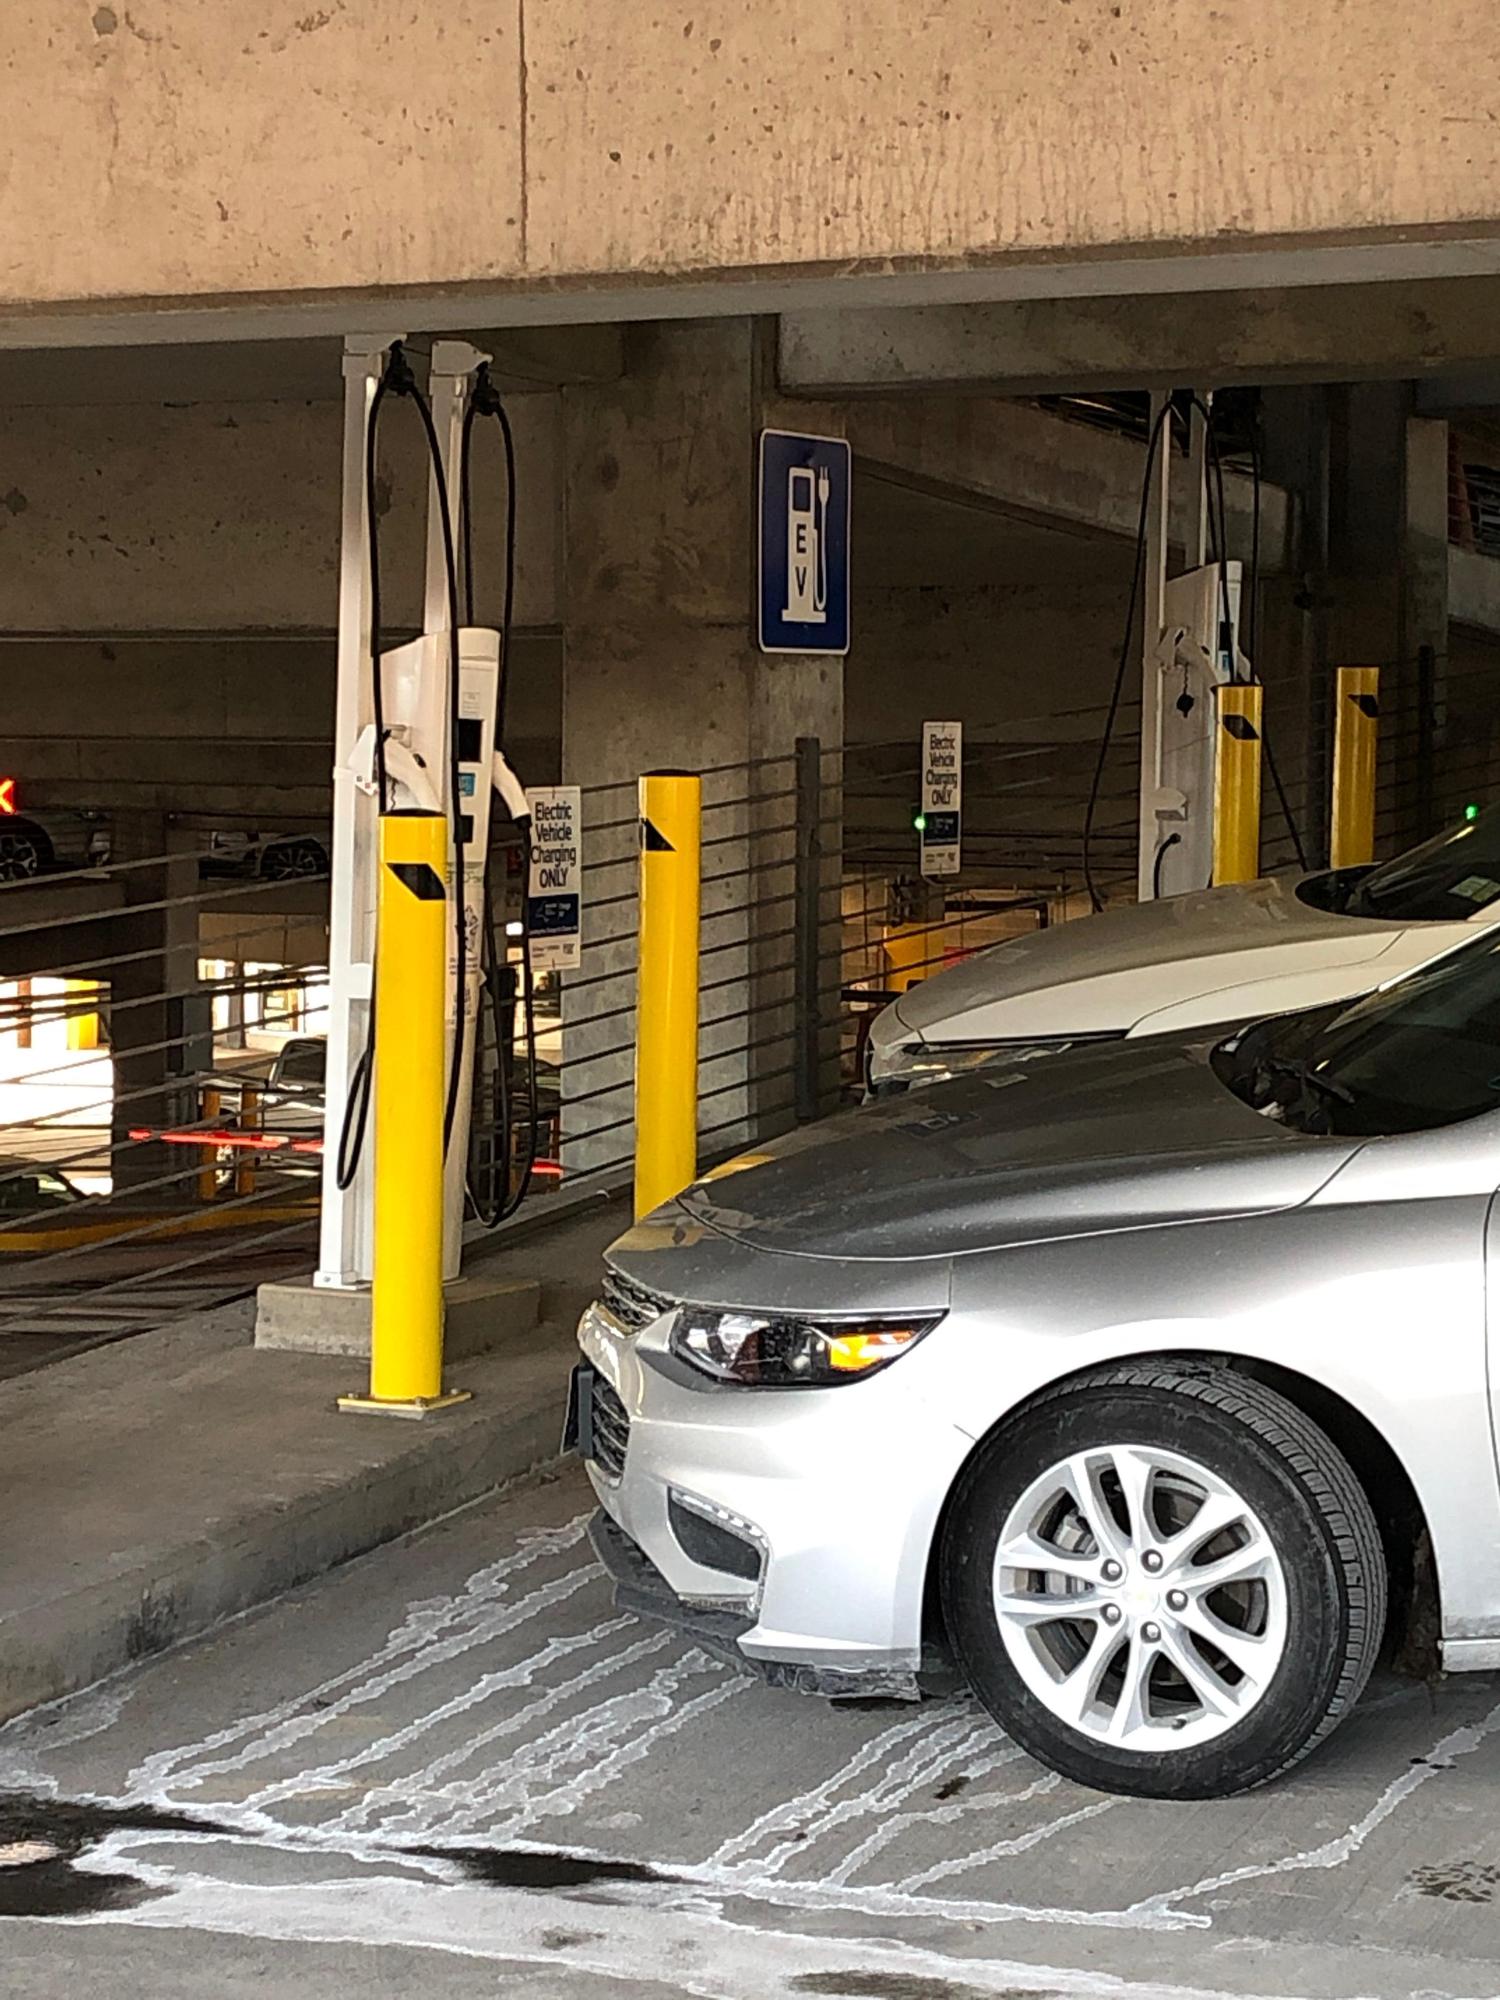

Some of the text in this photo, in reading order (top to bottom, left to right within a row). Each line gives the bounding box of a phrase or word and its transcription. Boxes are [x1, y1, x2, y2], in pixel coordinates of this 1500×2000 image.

[535, 801, 572, 821] Electric
[535, 822, 572, 842] Vehicle
[531, 843, 576, 867] Charging
[539, 868, 568, 888] ONLY
